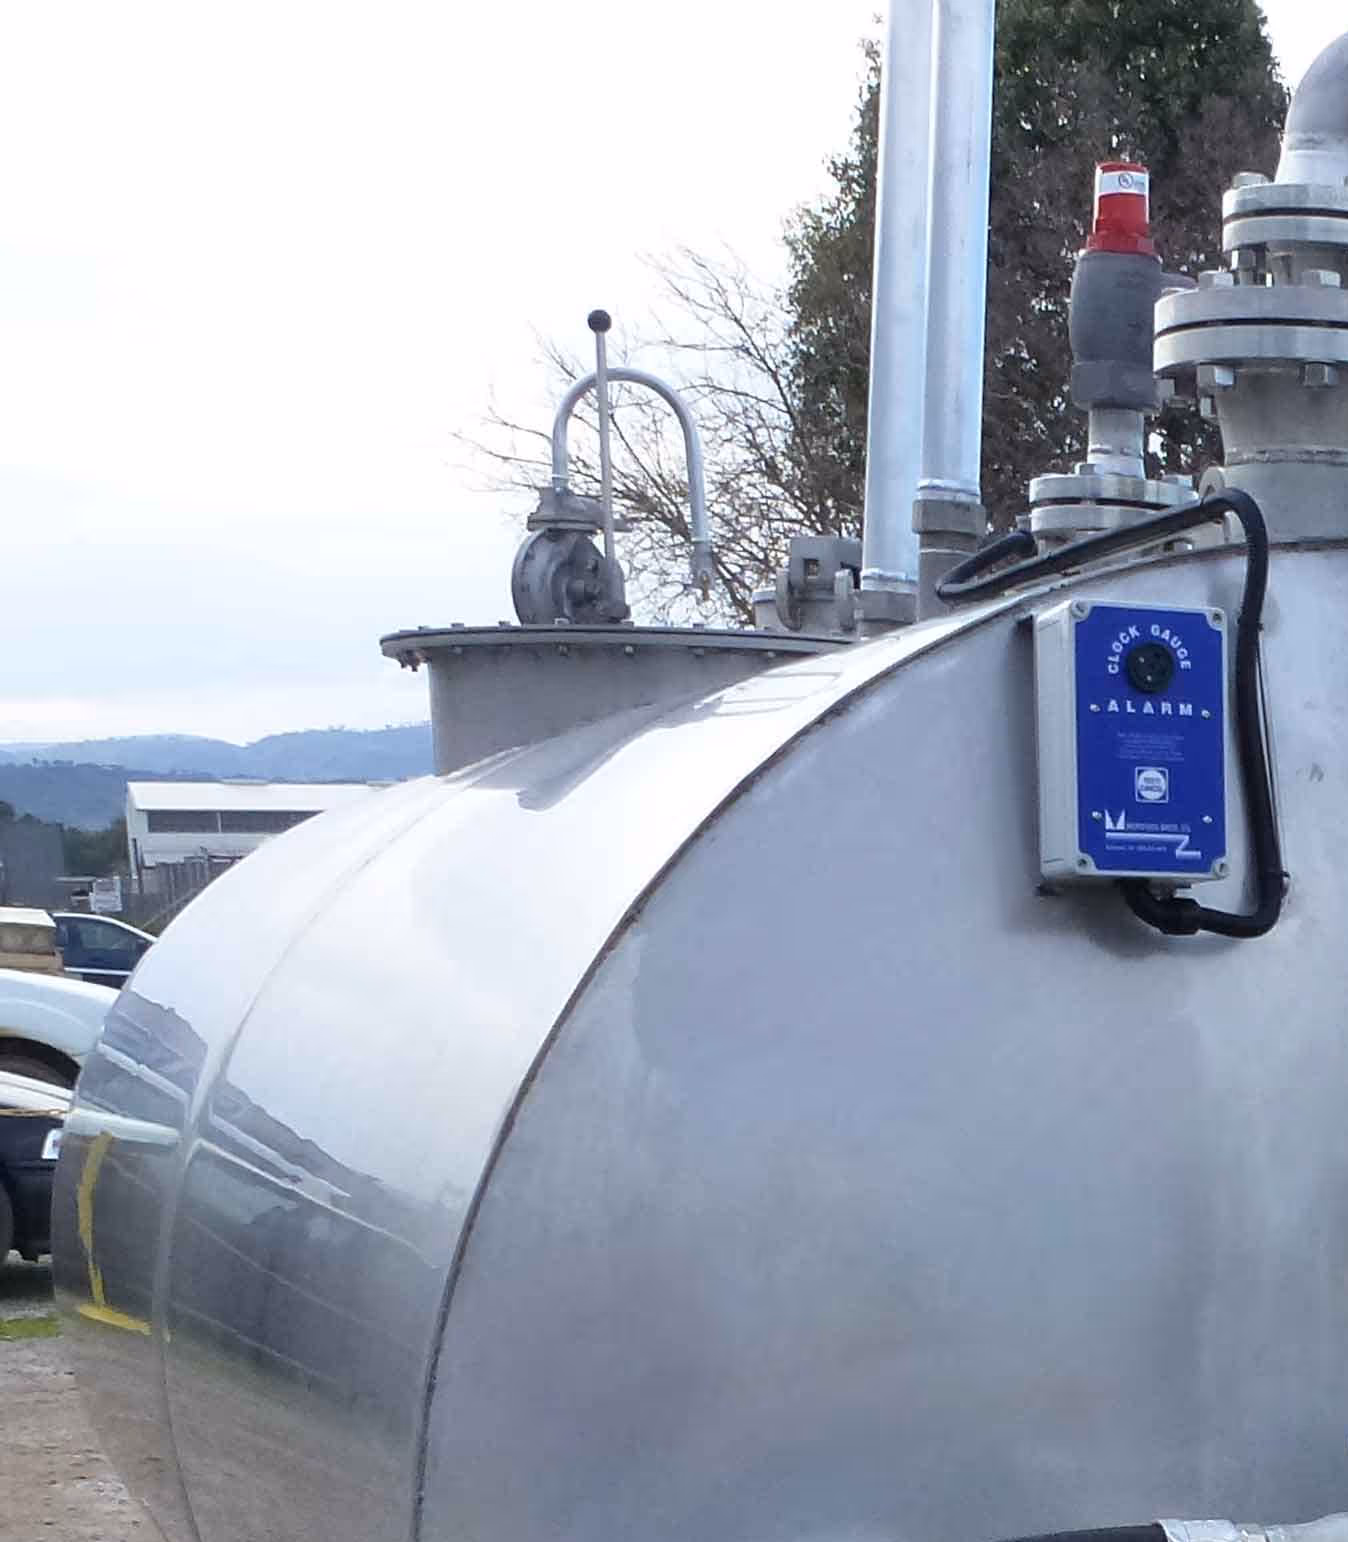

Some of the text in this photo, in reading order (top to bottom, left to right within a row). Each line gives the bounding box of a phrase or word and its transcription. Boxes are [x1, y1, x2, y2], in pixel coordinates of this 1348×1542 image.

[1107, 624, 1192, 674] CLOCK GAUGE
[1107, 699, 1193, 716] ALARM
